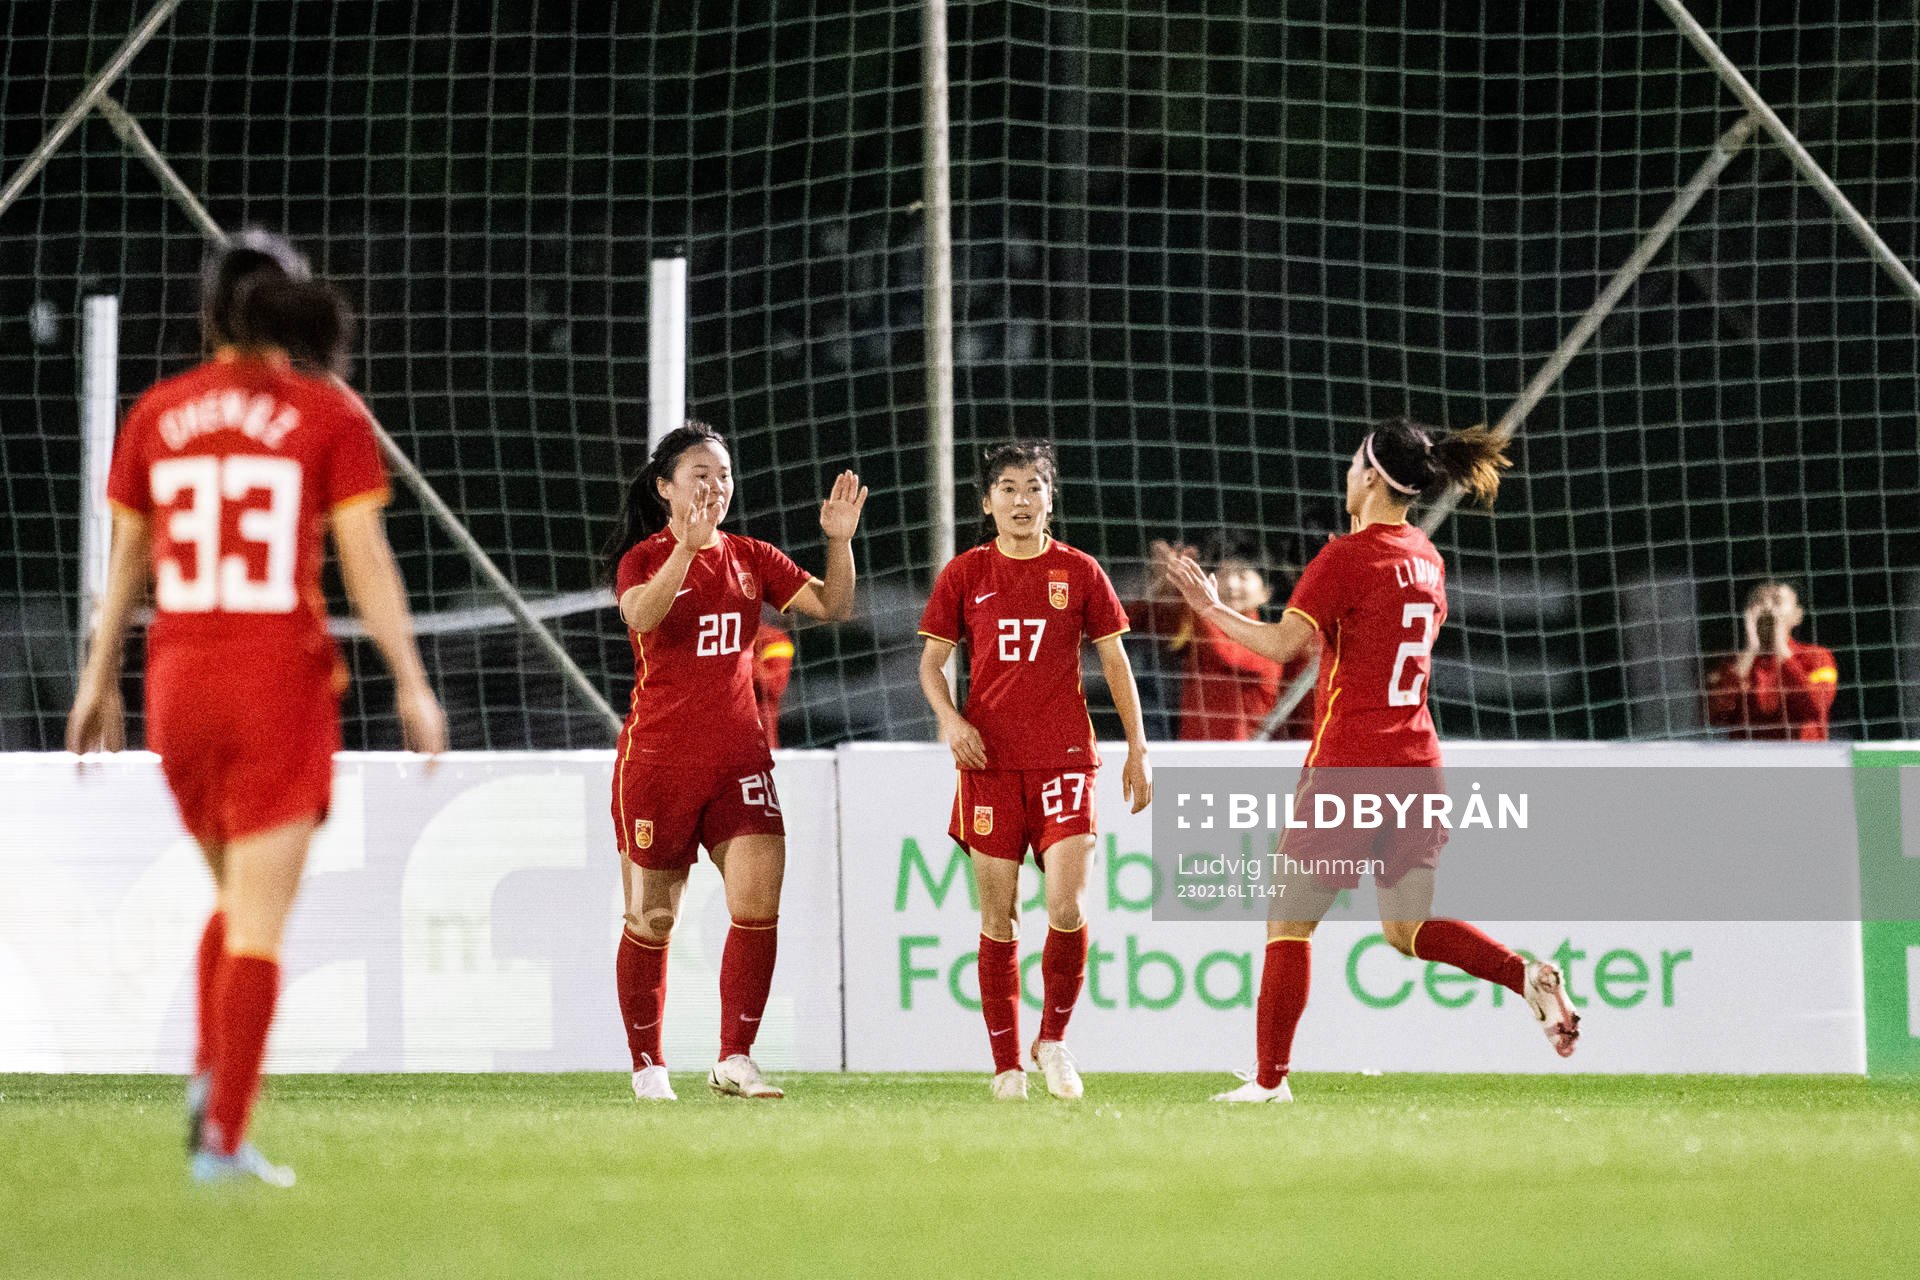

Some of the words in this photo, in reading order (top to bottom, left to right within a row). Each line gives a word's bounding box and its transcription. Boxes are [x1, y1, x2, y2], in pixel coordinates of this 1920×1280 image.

[150, 455, 302, 613] 33
[697, 612, 741, 657] 20
[998, 619, 1047, 662] 27
[1388, 603, 1436, 707] 2
[1041, 773, 1086, 817] 27
[895, 832, 1351, 913] Mbell
